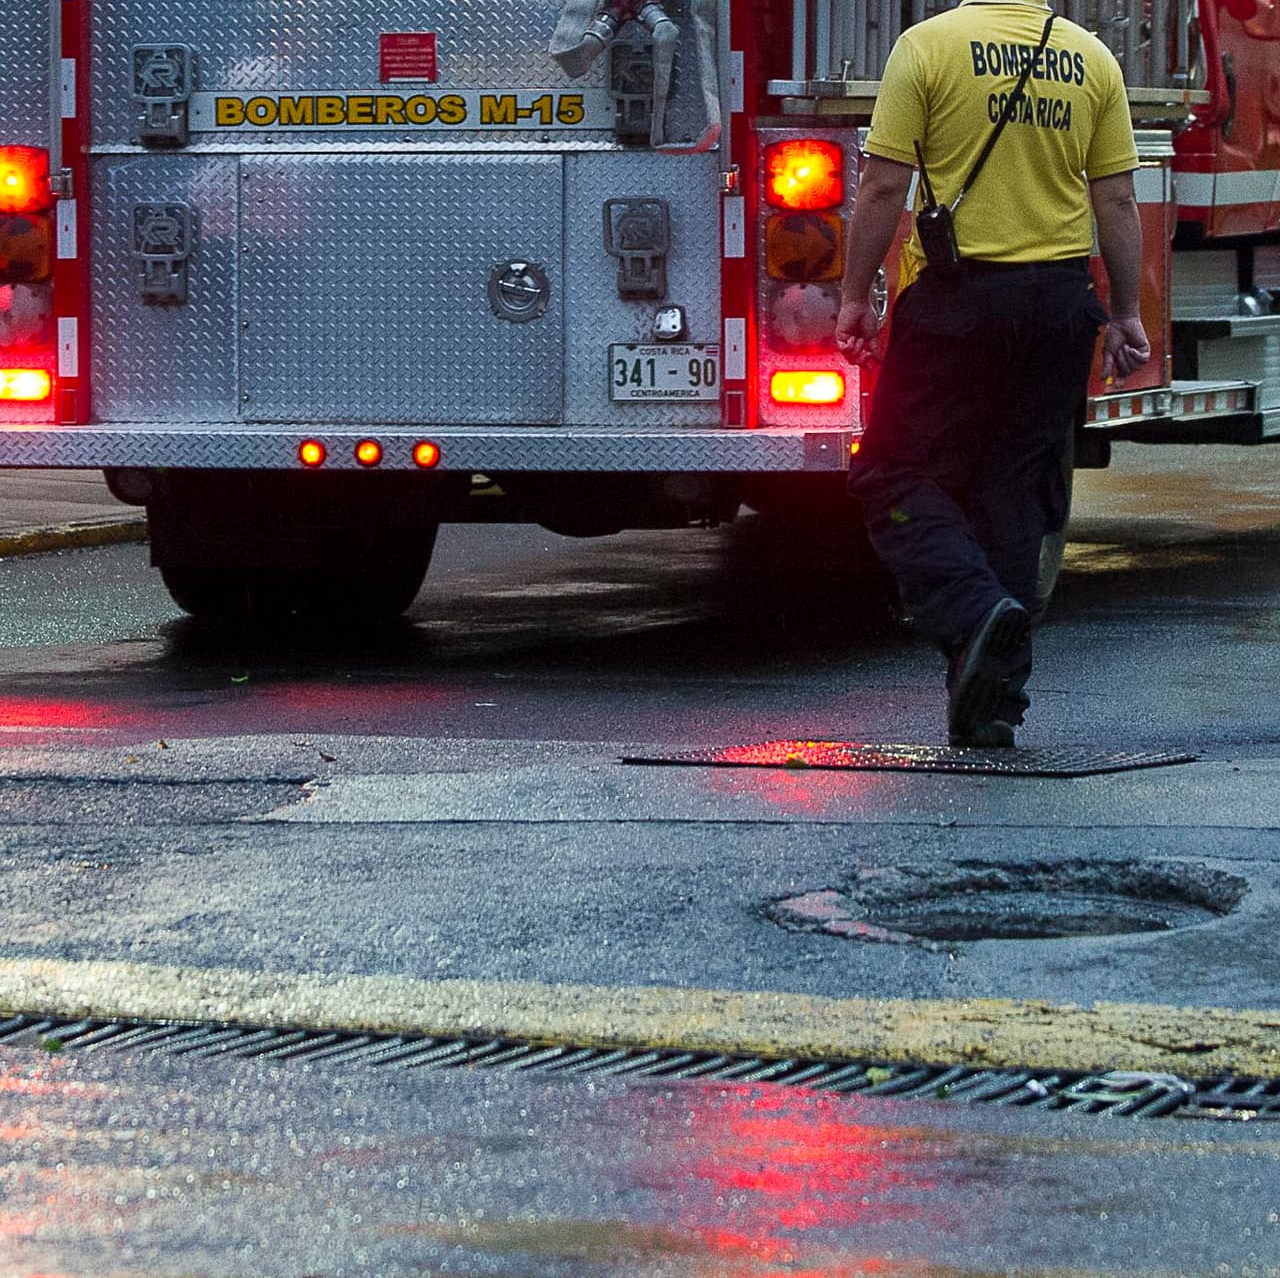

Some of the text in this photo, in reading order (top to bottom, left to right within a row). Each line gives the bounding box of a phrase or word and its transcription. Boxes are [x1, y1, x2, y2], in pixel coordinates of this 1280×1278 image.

[970, 41, 1085, 86] BOMBEROS
[215, 94, 585, 126] BOMBEROS M-15
[1036, 97, 1072, 131] RICA
[630, 389, 700, 397] CENTROAMERICA
